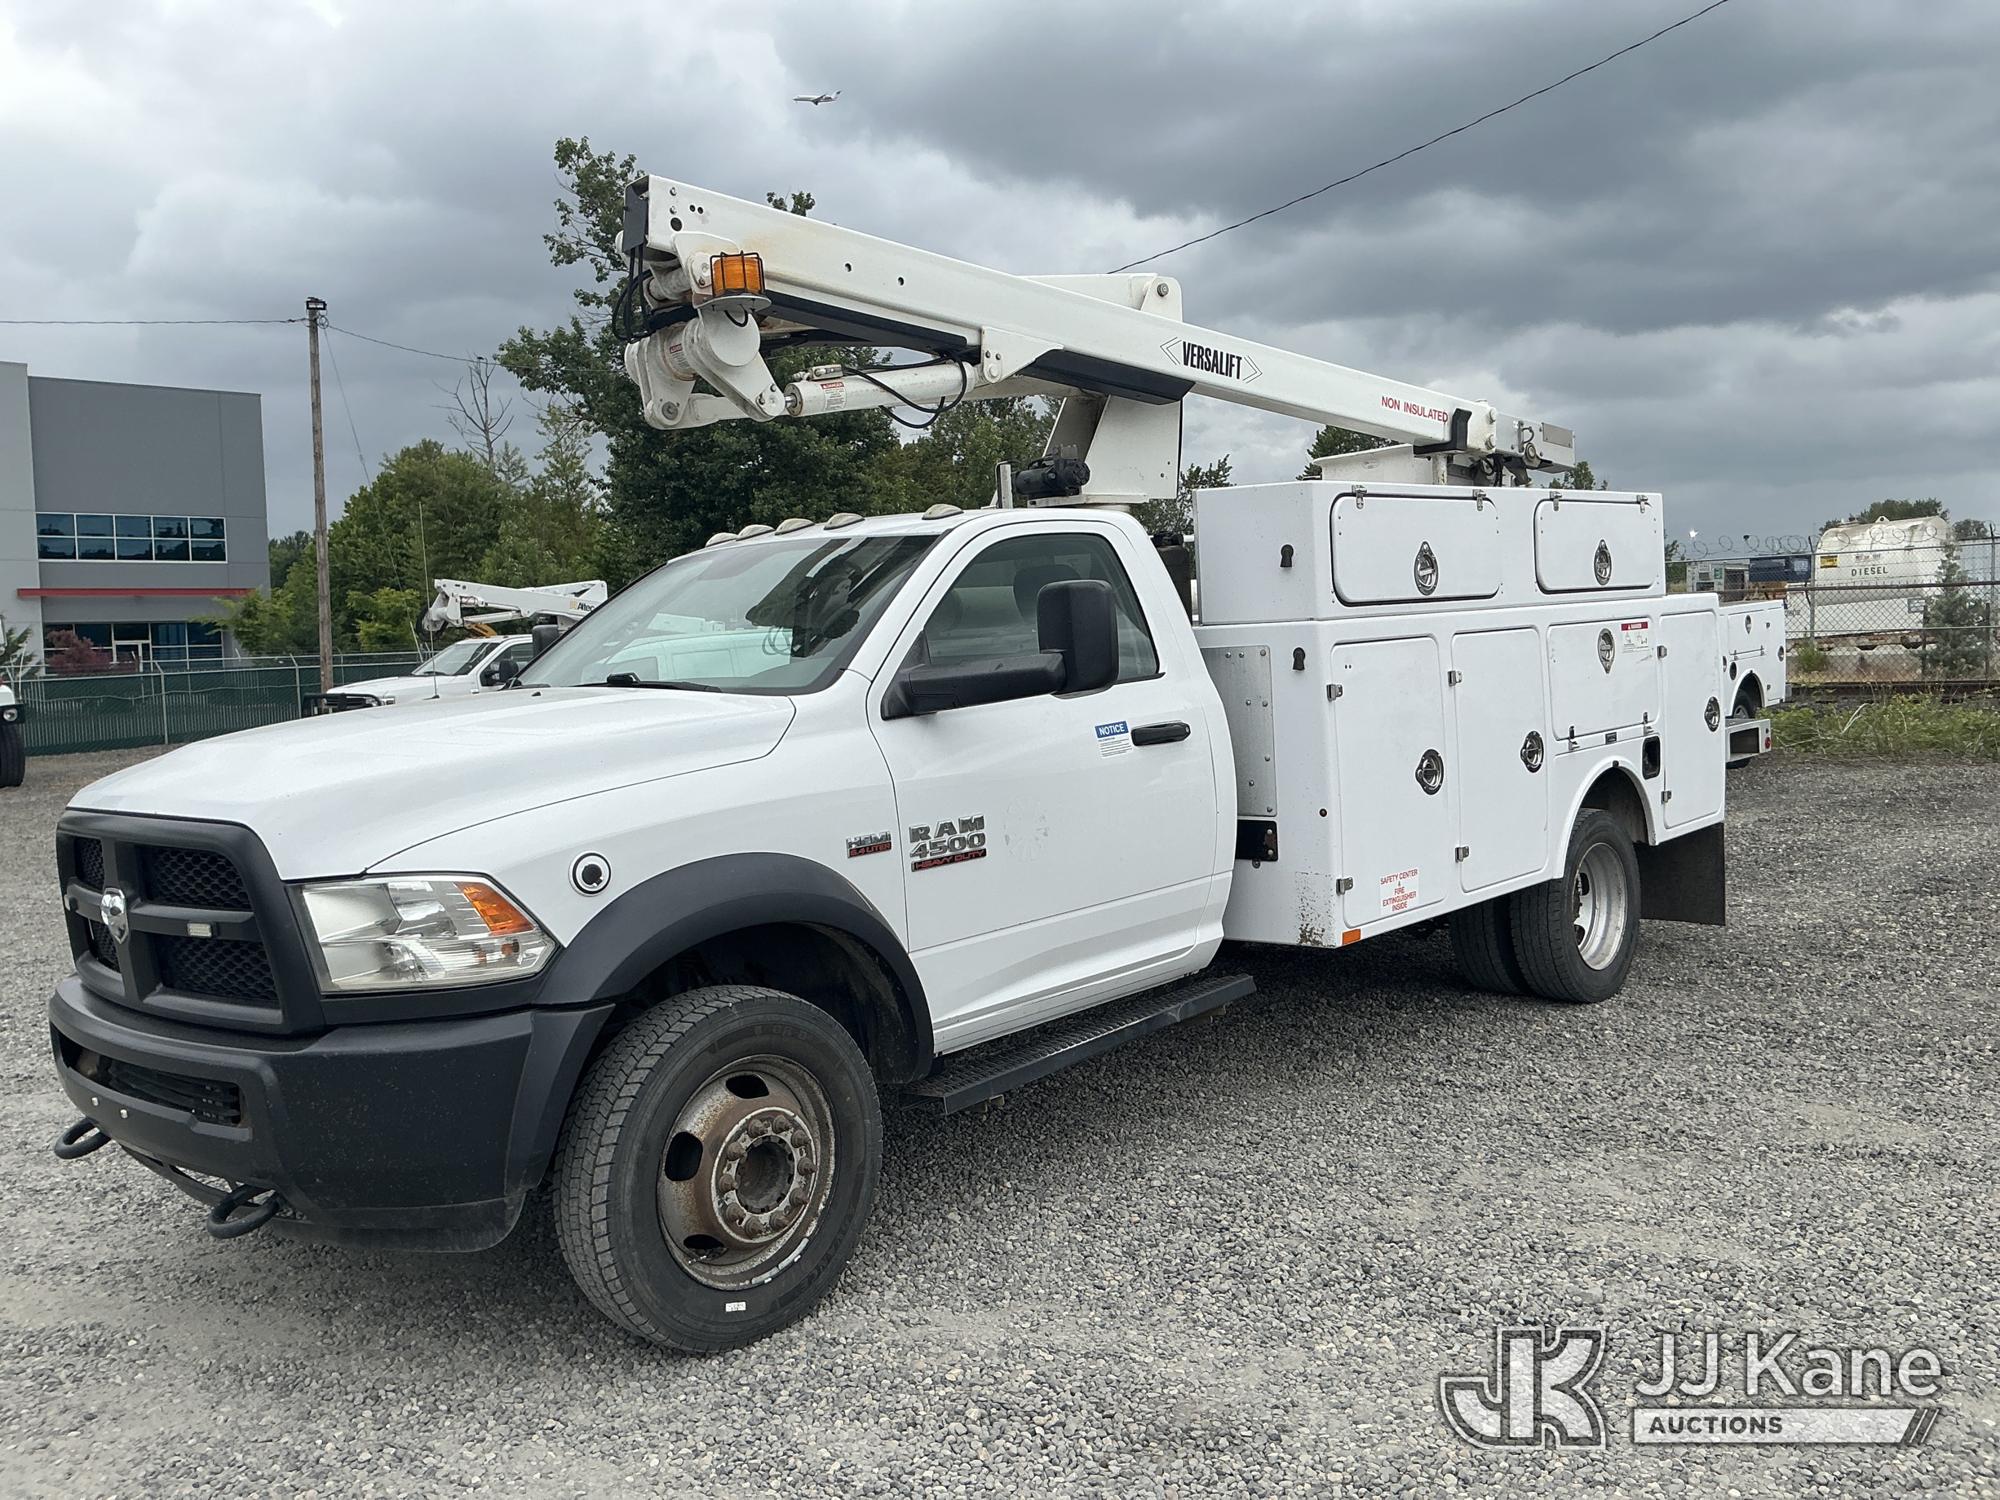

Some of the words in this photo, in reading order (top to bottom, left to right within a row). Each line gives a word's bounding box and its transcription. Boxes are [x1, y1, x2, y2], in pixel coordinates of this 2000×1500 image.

[1182, 341, 1242, 380] VERSALIFT
[1381, 396, 1401, 411] NON
[1403, 402, 1448, 422] INSULATED
[1851, 566, 1889, 577] DIESEL
[1098, 723, 1126, 736] NOTICE
[909, 814, 985, 843] RAM
[846, 831, 892, 848] HEMI
[866, 842, 891, 853] LITER
[909, 832, 986, 858] 4500
[915, 856, 953, 869] HEAVY
[954, 849, 984, 863] DUTY
[1380, 873, 1399, 885] SAFETY
[1399, 869, 1418, 880] CENTER
[1382, 890, 1417, 907] EXTINGUISHER
[1394, 886, 1405, 895] FIRE
[1391, 901, 1408, 911] INSIDE
